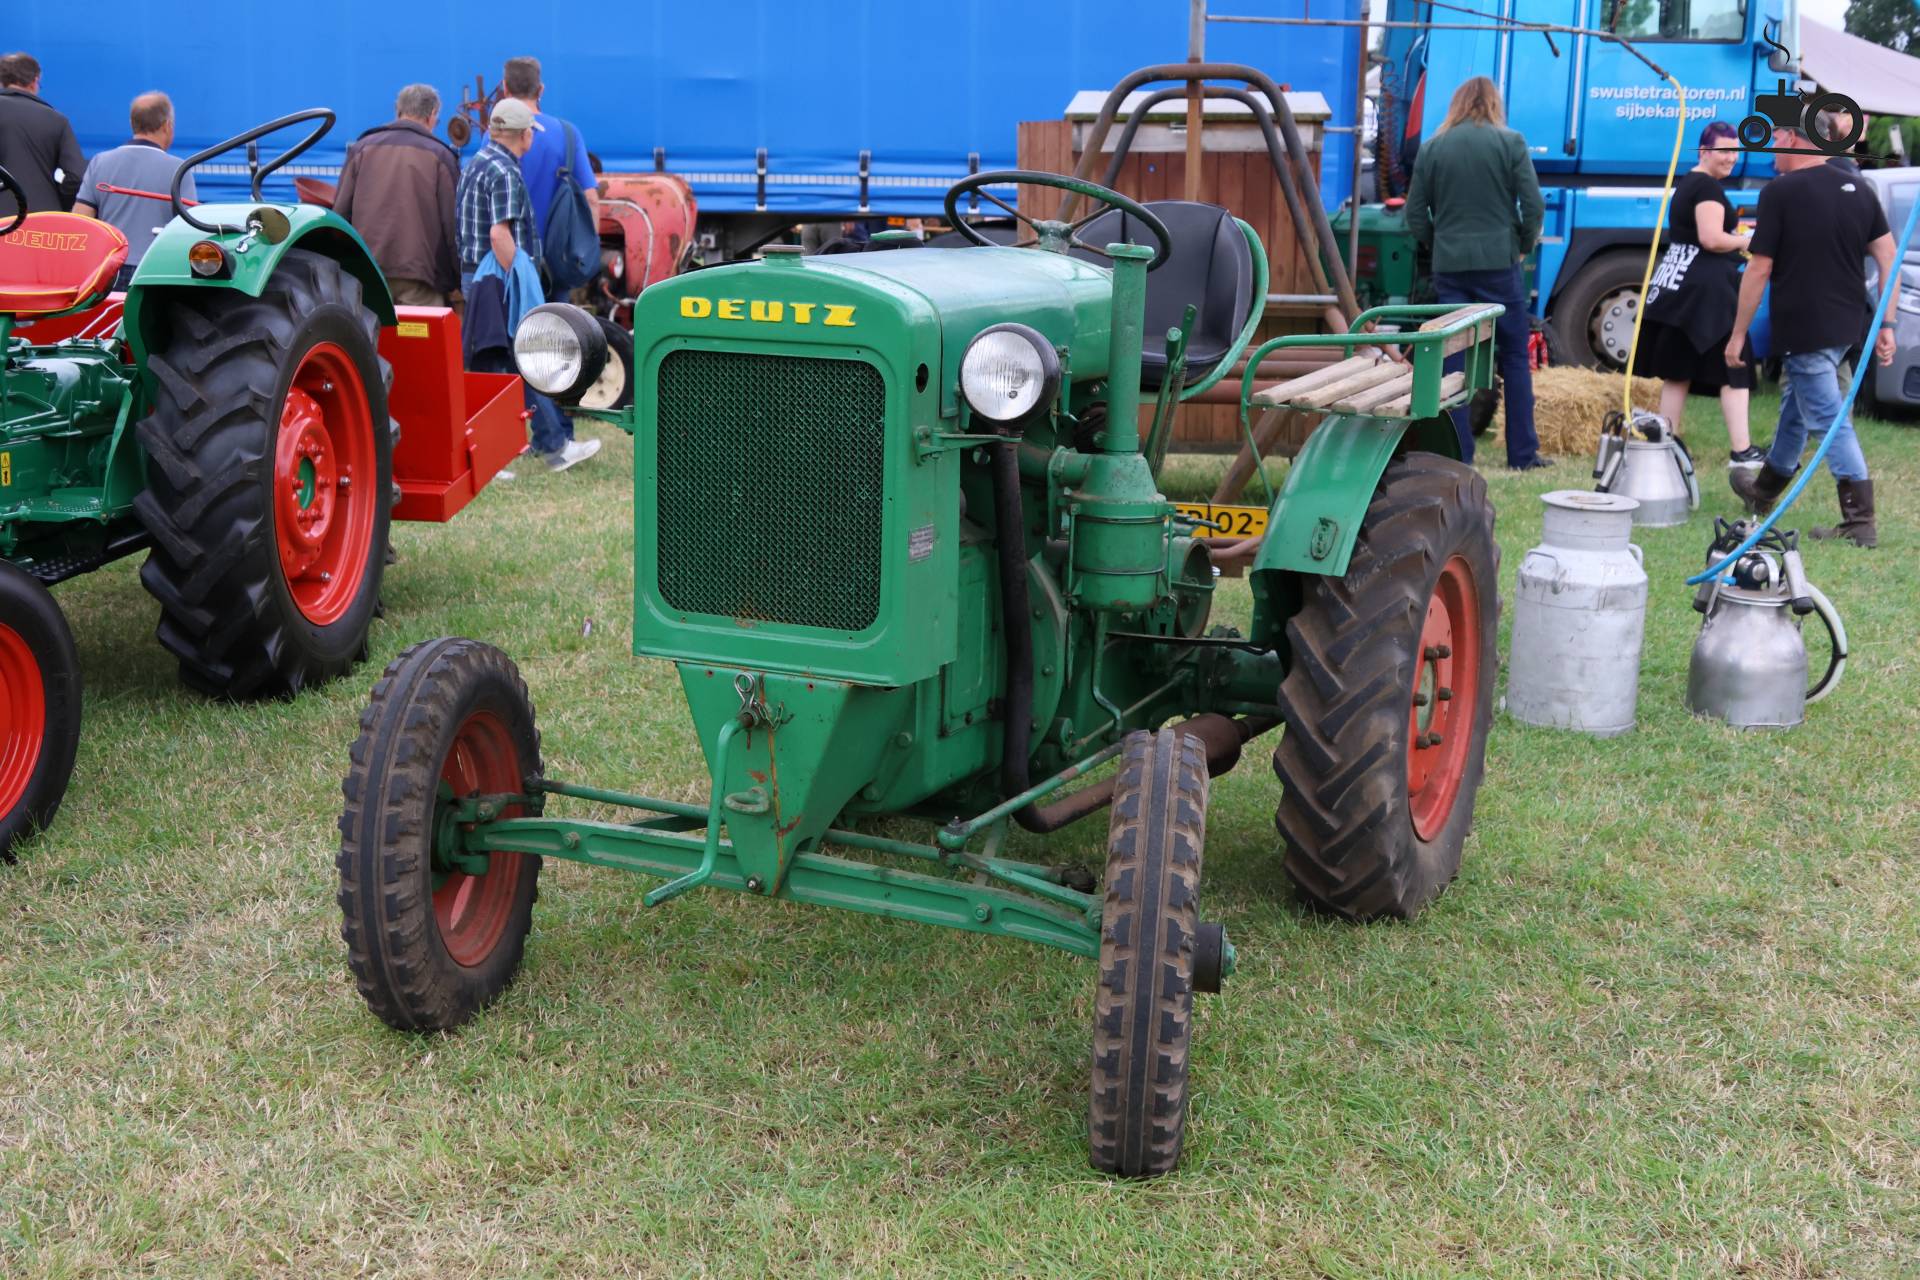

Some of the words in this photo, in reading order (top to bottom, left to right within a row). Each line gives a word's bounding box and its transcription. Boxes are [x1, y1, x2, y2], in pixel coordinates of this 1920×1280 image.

[1590, 86, 1746, 101] swustetractoren.nl
[4, 228, 88, 251] DEUTZ
[680, 296, 857, 327] DEUTZ
